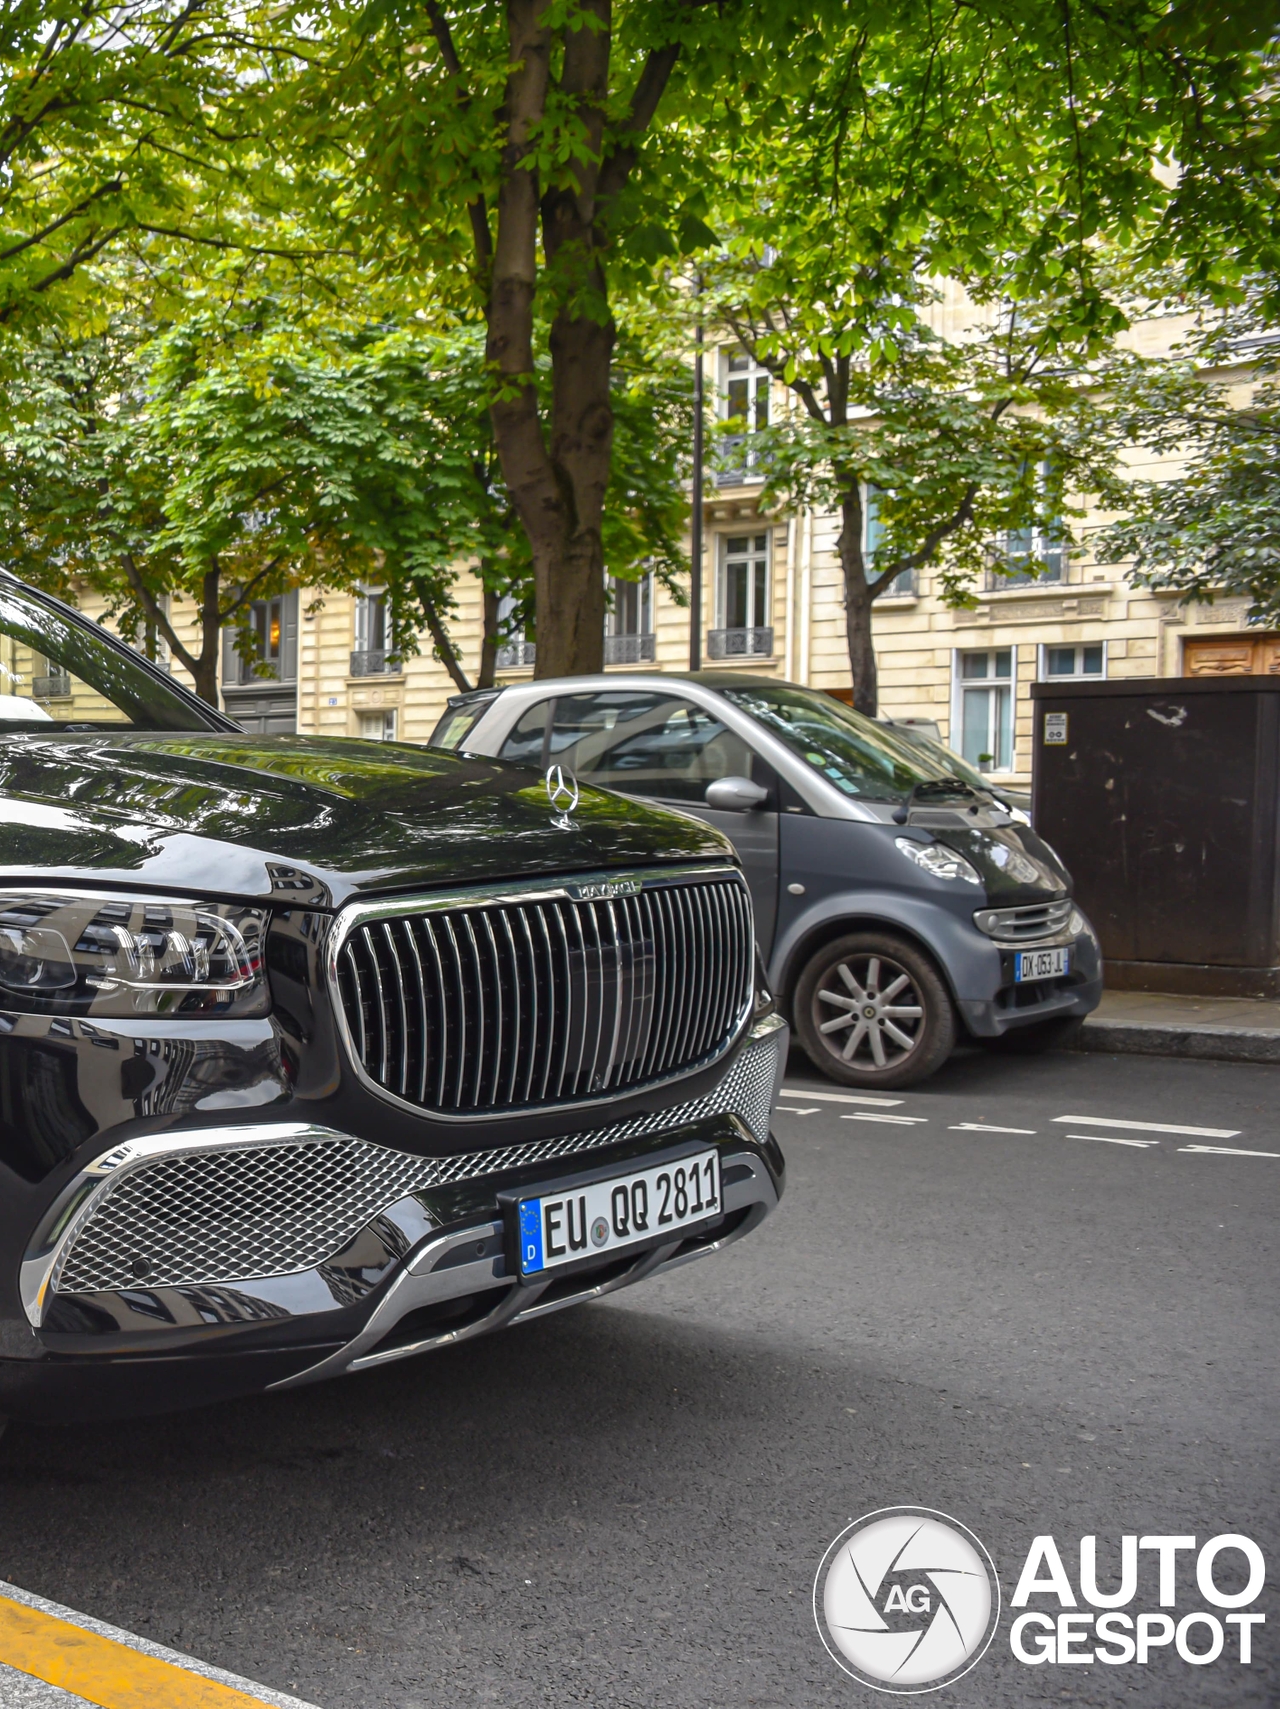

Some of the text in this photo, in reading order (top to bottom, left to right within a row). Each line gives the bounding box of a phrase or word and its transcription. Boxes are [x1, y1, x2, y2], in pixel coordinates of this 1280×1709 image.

[545, 1157, 718, 1258] EU QQ 2811
[527, 1244, 536, 1261] D
